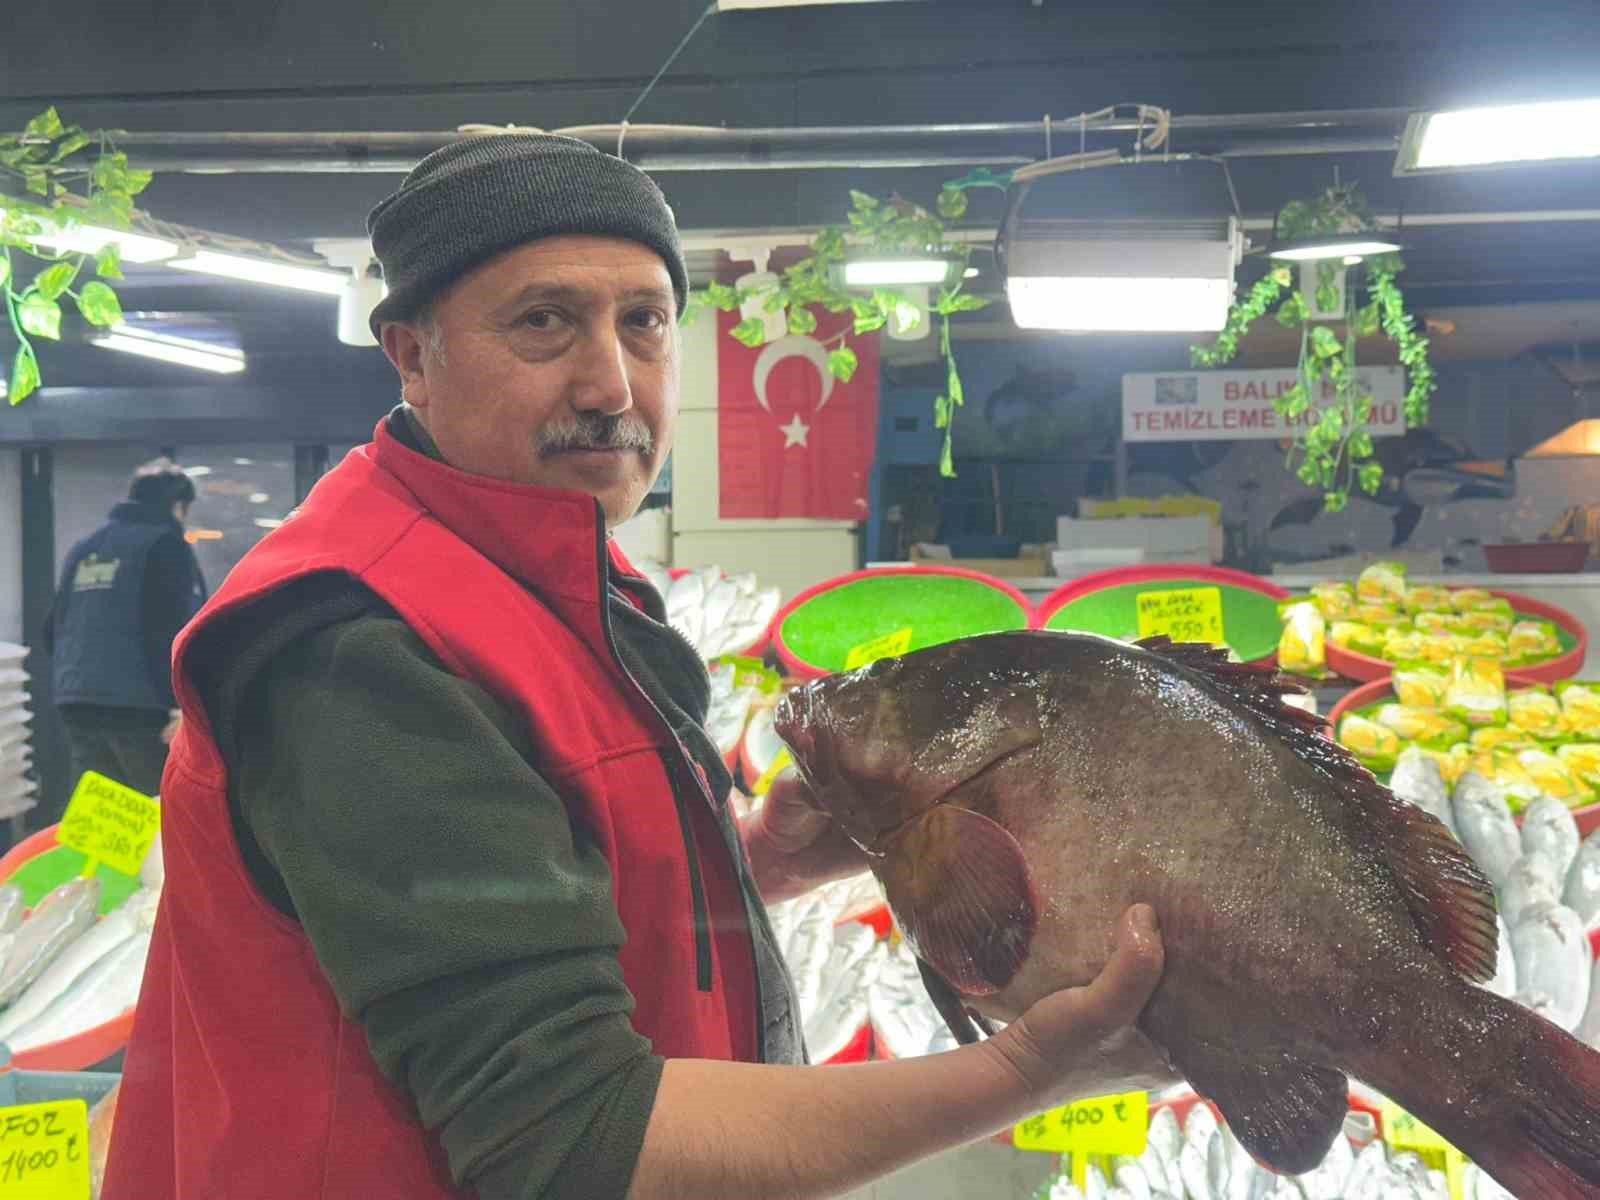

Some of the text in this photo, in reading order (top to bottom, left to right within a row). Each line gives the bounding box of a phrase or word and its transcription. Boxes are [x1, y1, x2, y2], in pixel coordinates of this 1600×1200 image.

[1132, 406, 1276, 432] TEMİZLEME
[0, 1111, 66, 1141] FOZ
[1061, 1104, 1105, 1134] 400
